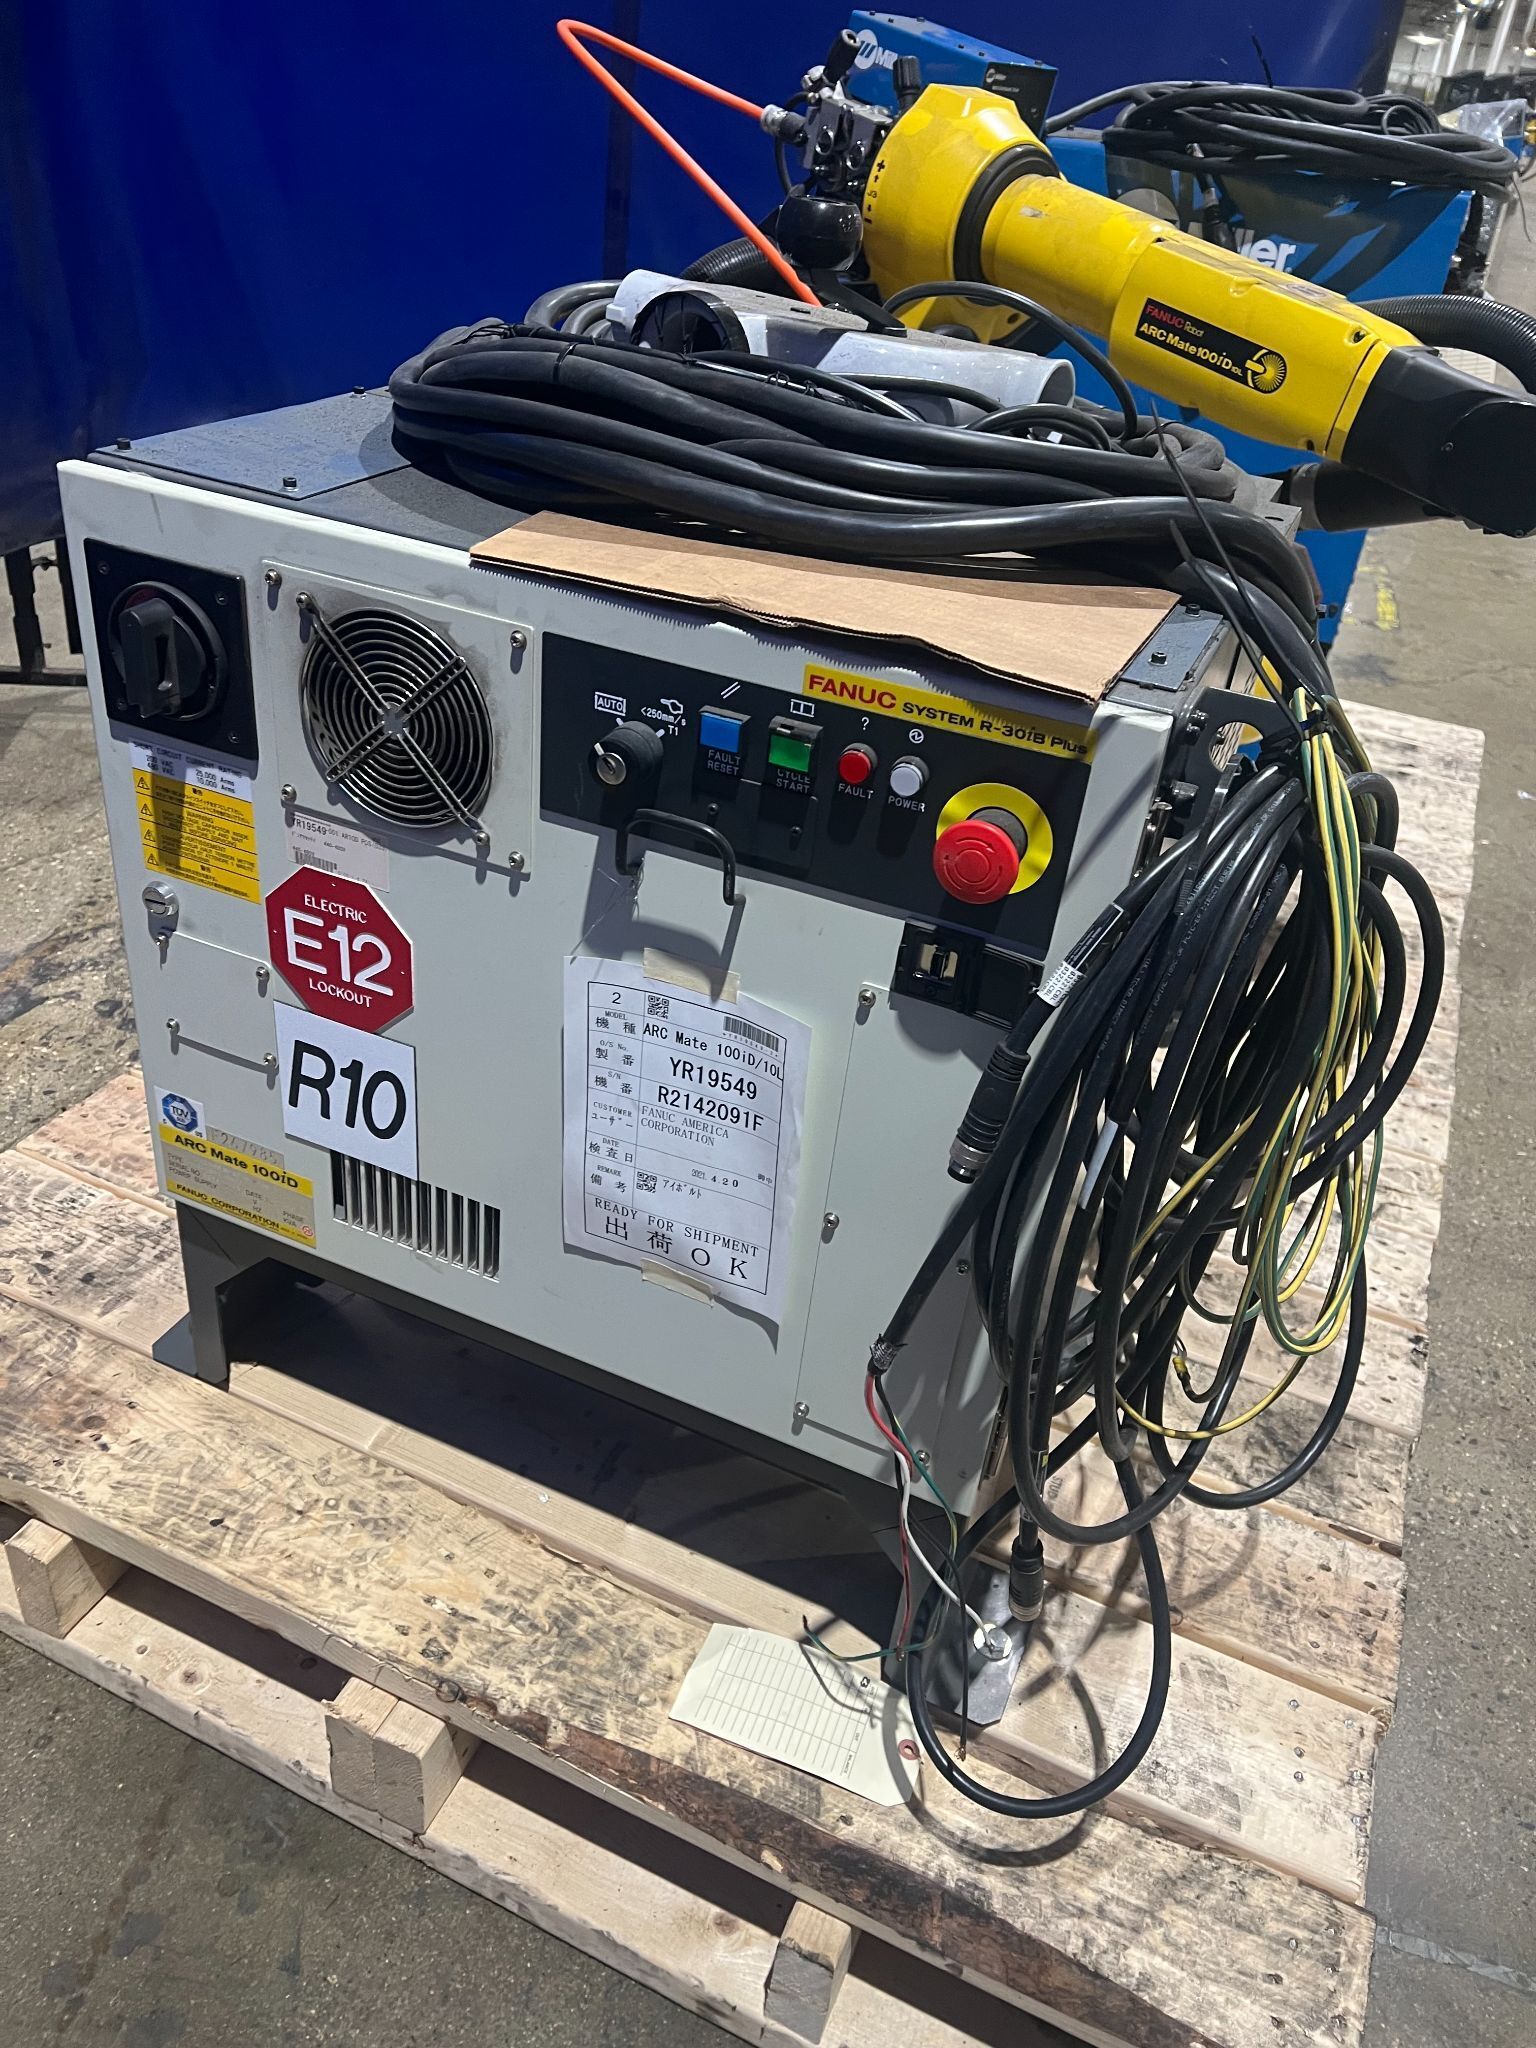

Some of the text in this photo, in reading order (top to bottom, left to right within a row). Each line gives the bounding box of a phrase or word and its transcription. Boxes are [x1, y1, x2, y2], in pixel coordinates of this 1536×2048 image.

[874, 46, 899, 70] Mil
[1145, 304, 1205, 337] FANUC Robot
[1139, 322, 1167, 340] ARC
[1166, 333, 1197, 354] Mate
[597, 697, 623, 712] AUTO
[808, 674, 1088, 755] FANUC SYSTEM R-30iB Plus
[641, 706, 687, 727] <250mm/s
[667, 724, 679, 736] T1
[707, 759, 740, 776] RESET
[708, 749, 742, 766] FAULT
[776, 778, 811, 794] START
[777, 767, 811, 784] CYCLE
[838, 782, 874, 800] FAULT
[887, 795, 926, 813] POWER
[304, 894, 367, 924] ELECTRIC
[283, 906, 394, 997] E12
[308, 977, 372, 1008] LOCKOUT
[611, 991, 622, 1005] 2
[604, 1009, 628, 1021] MODEL
[599, 1039, 629, 1052] O/S No.
[642, 1022, 783, 1081] ARC Mate 100iD/10L
[607, 1071, 622, 1080] S/N
[669, 1056, 757, 1100] YR19549
[288, 1039, 407, 1140] R10
[593, 1101, 633, 1117] CUSTOMER
[657, 1085, 764, 1132] R2142091F
[640, 1117, 715, 1147] CORPORATION
[641, 1105, 729, 1139] FANUC AMERICA
[588, 1141, 633, 1163] 検査日
[602, 1137, 620, 1148] DATE
[174, 1134, 298, 1189] ARC Mate 100iD
[597, 1164, 622, 1177] REMARK
[590, 1173, 627, 1194] 備考
[245, 1189, 262, 1200] DATE
[176, 1183, 280, 1229] FANUC CORPORATION
[594, 1197, 759, 1258] READY FOR SHIPMENT
[605, 1216, 673, 1255] 出荷
